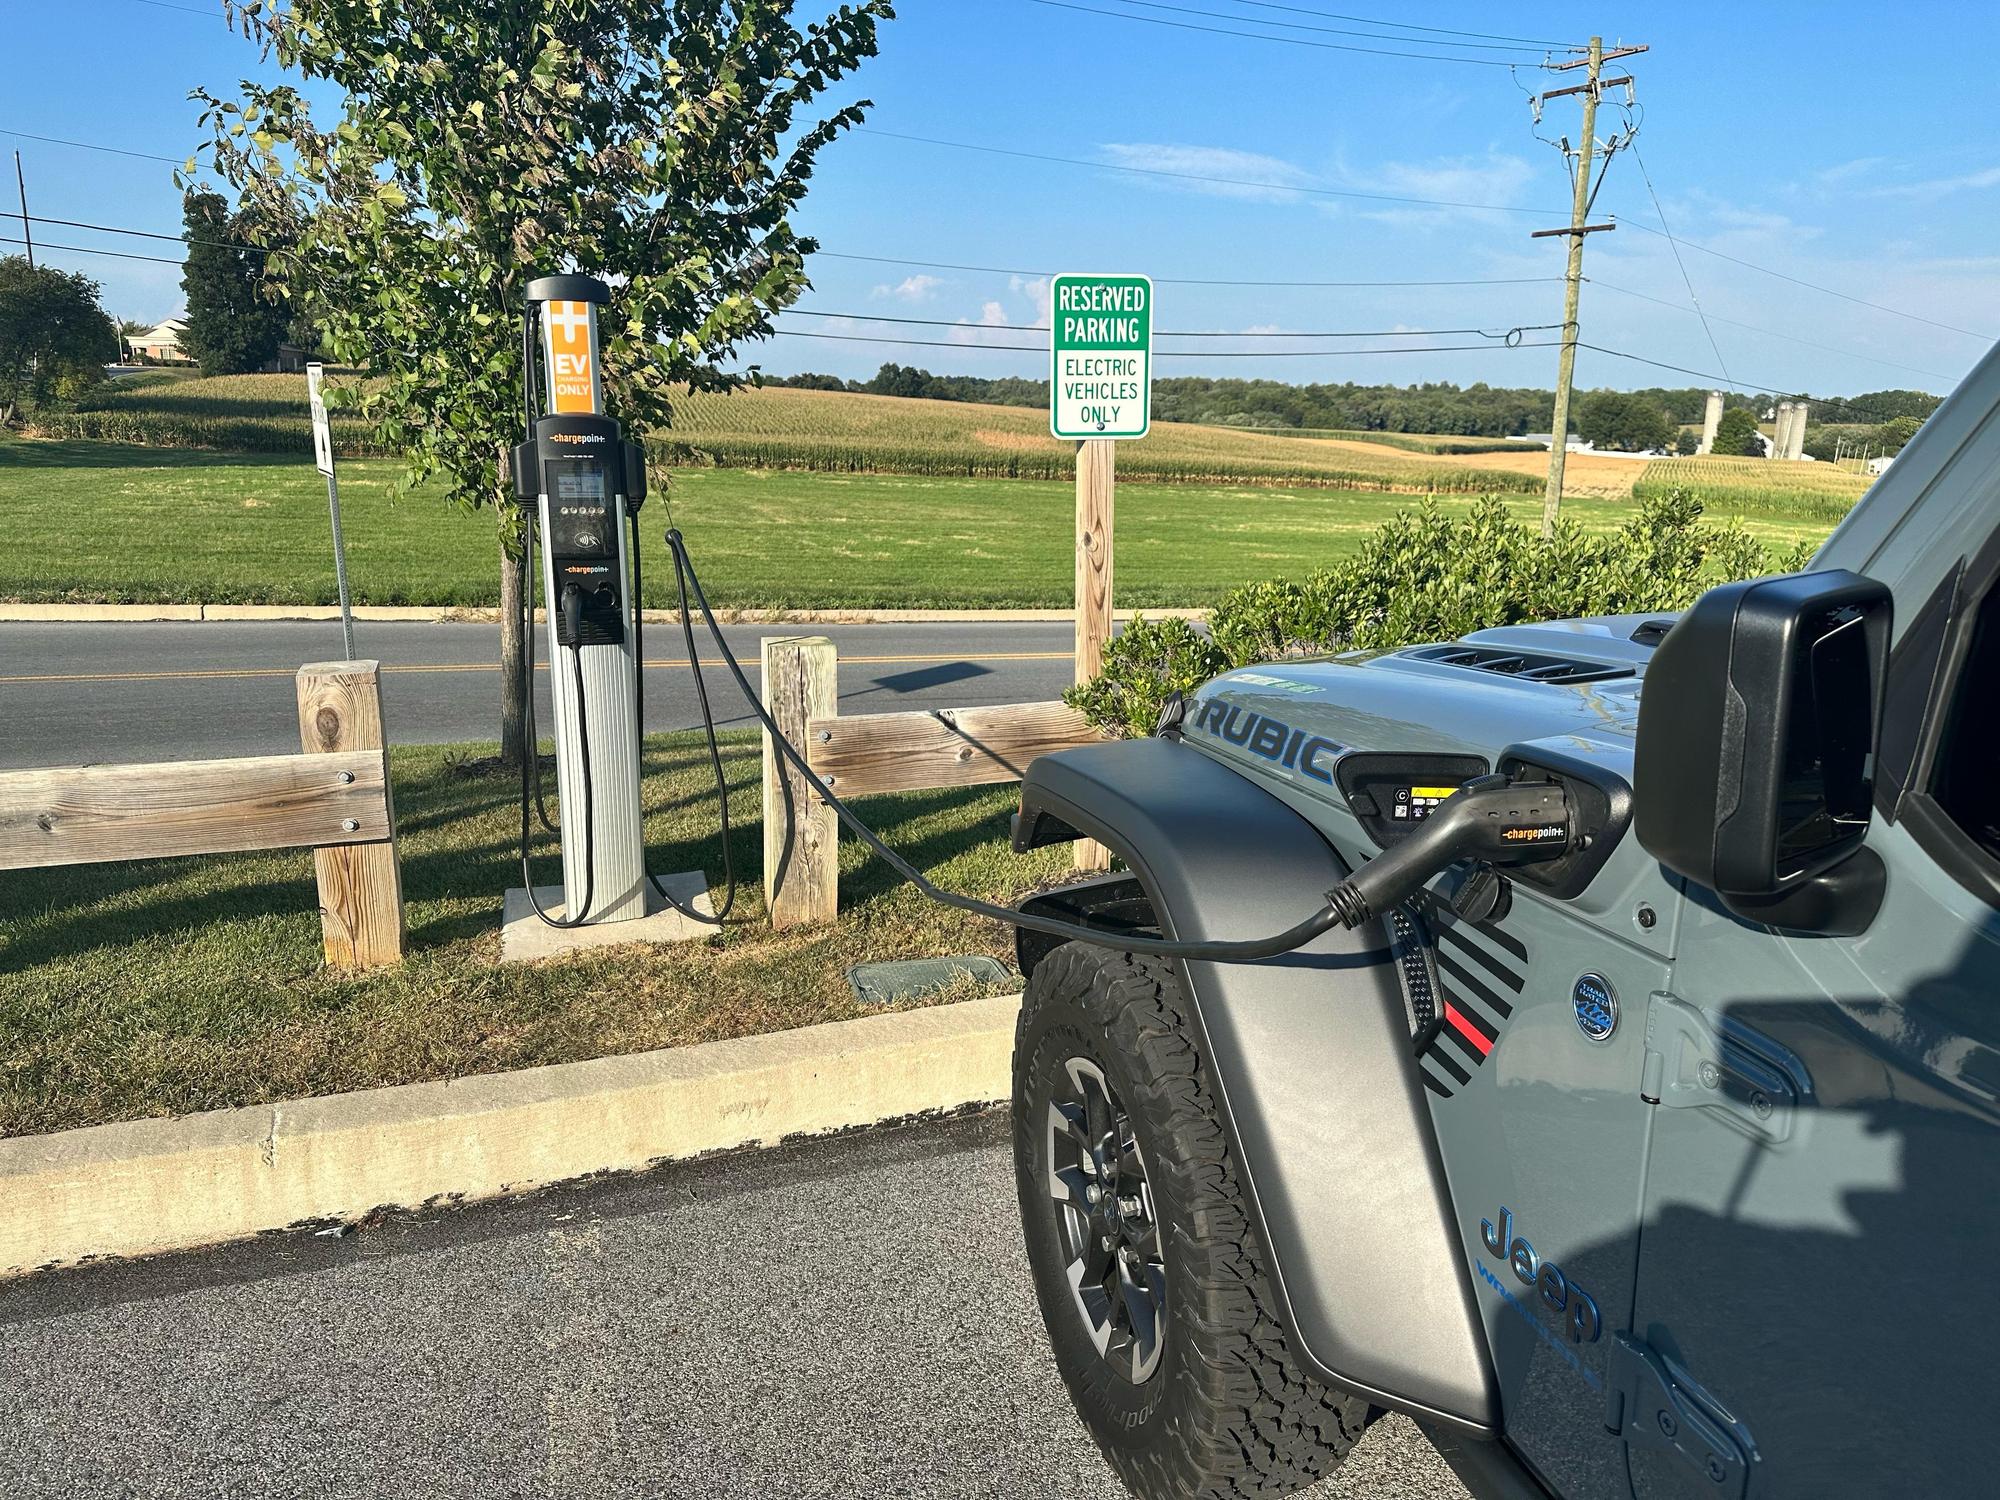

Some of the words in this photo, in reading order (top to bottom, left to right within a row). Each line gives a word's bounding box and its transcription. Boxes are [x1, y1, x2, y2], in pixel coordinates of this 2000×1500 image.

[1059, 285, 1145, 312] RESERVED
[1064, 317, 1140, 343] PARKING
[555, 353, 588, 375] EV
[1066, 358, 1137, 376] ELECTRIC
[556, 384, 590, 396] ONLY
[1065, 382, 1138, 400] VEHICLES
[1080, 406, 1121, 423] ONLY
[1195, 699, 1346, 786] RUBIC
[1480, 1206, 1600, 1344] Jeep
